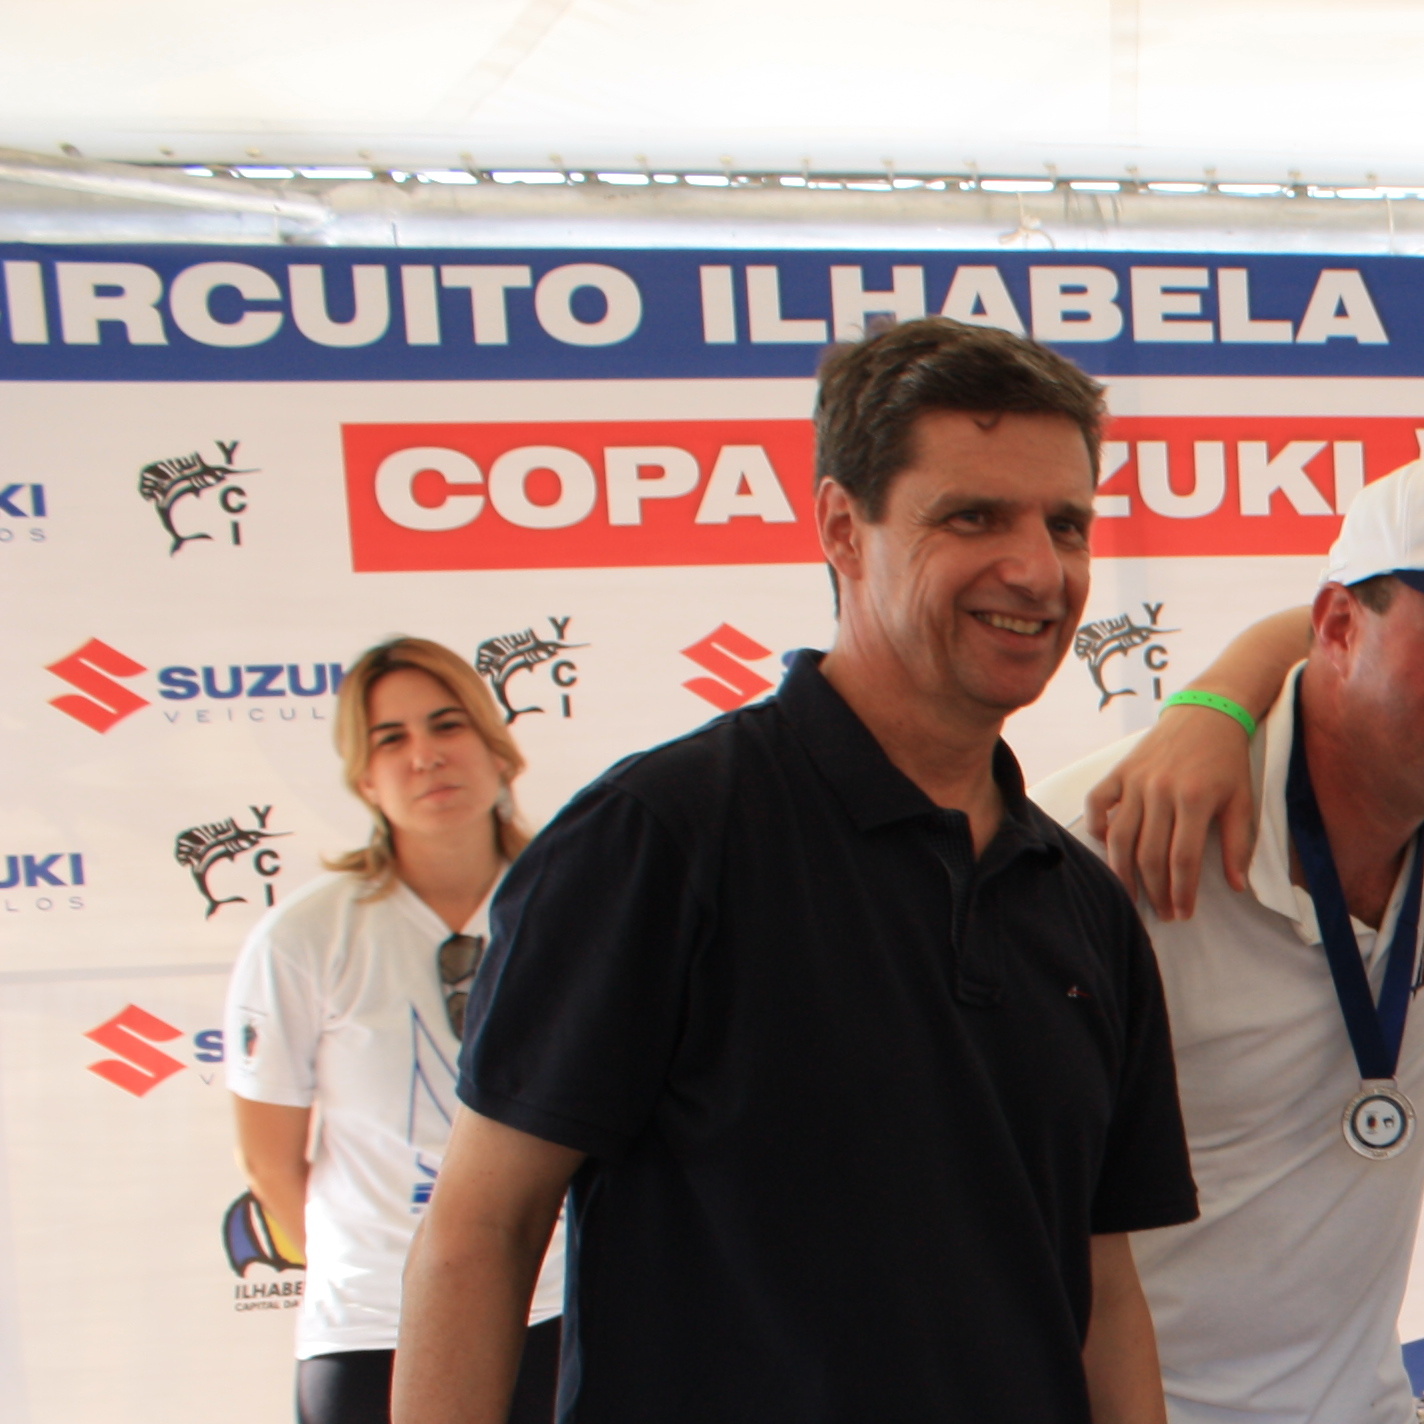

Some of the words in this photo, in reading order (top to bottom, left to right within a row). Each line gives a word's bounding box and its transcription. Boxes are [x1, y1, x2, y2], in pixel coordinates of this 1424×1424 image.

[699, 264, 1389, 346] ILHABELA
[375, 445, 797, 531] COPA
[235, 1280, 304, 1300] ILHABE
[235, 1301, 282, 1312] CAPITAL
